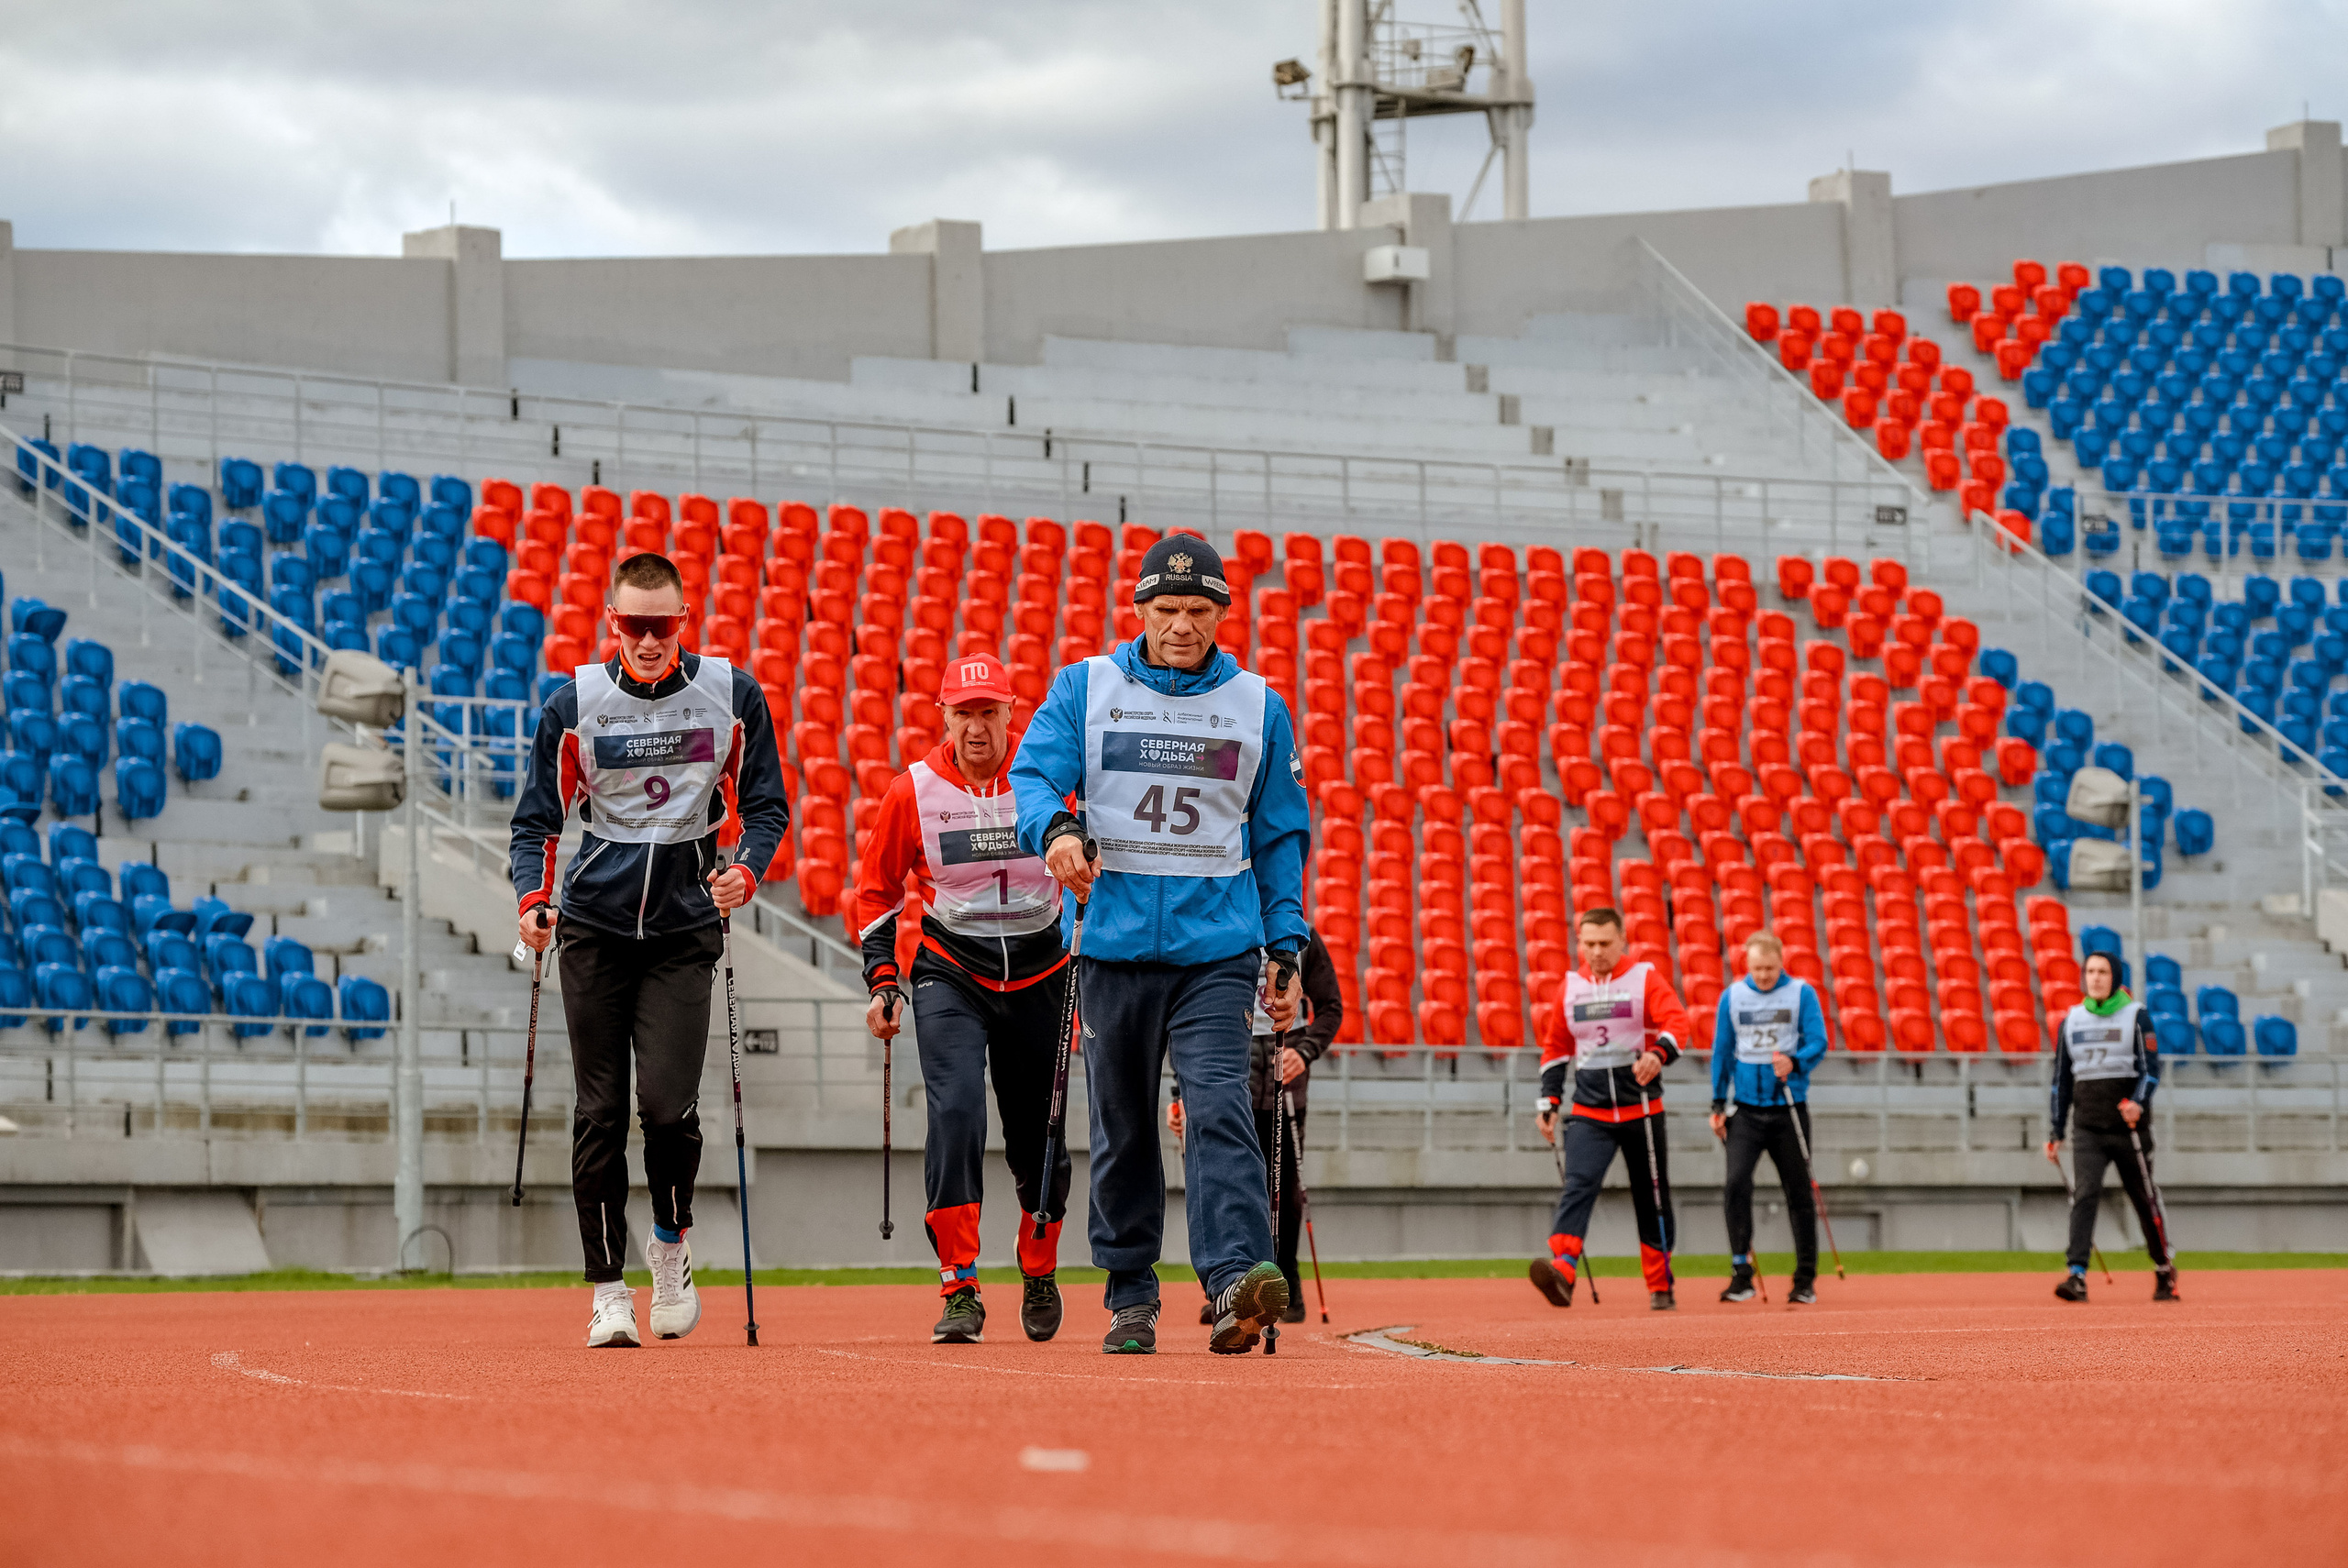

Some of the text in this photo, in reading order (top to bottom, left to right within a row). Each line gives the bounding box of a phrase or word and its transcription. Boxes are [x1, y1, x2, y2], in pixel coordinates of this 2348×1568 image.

[960, 662, 989, 681] ГТО
[626, 735, 682, 748] СЕВЕРНАЯ
[1140, 738, 1206, 752] СЕВЕРНАЯ
[644, 776, 670, 811] 9
[1134, 785, 1201, 835] 45
[969, 832, 1015, 842] СЕВЕРНА
[991, 869, 1008, 905] 1
[1597, 1025, 1609, 1046] 3
[1754, 1029, 1778, 1048] 25
[2084, 1048, 2107, 1065] 77
